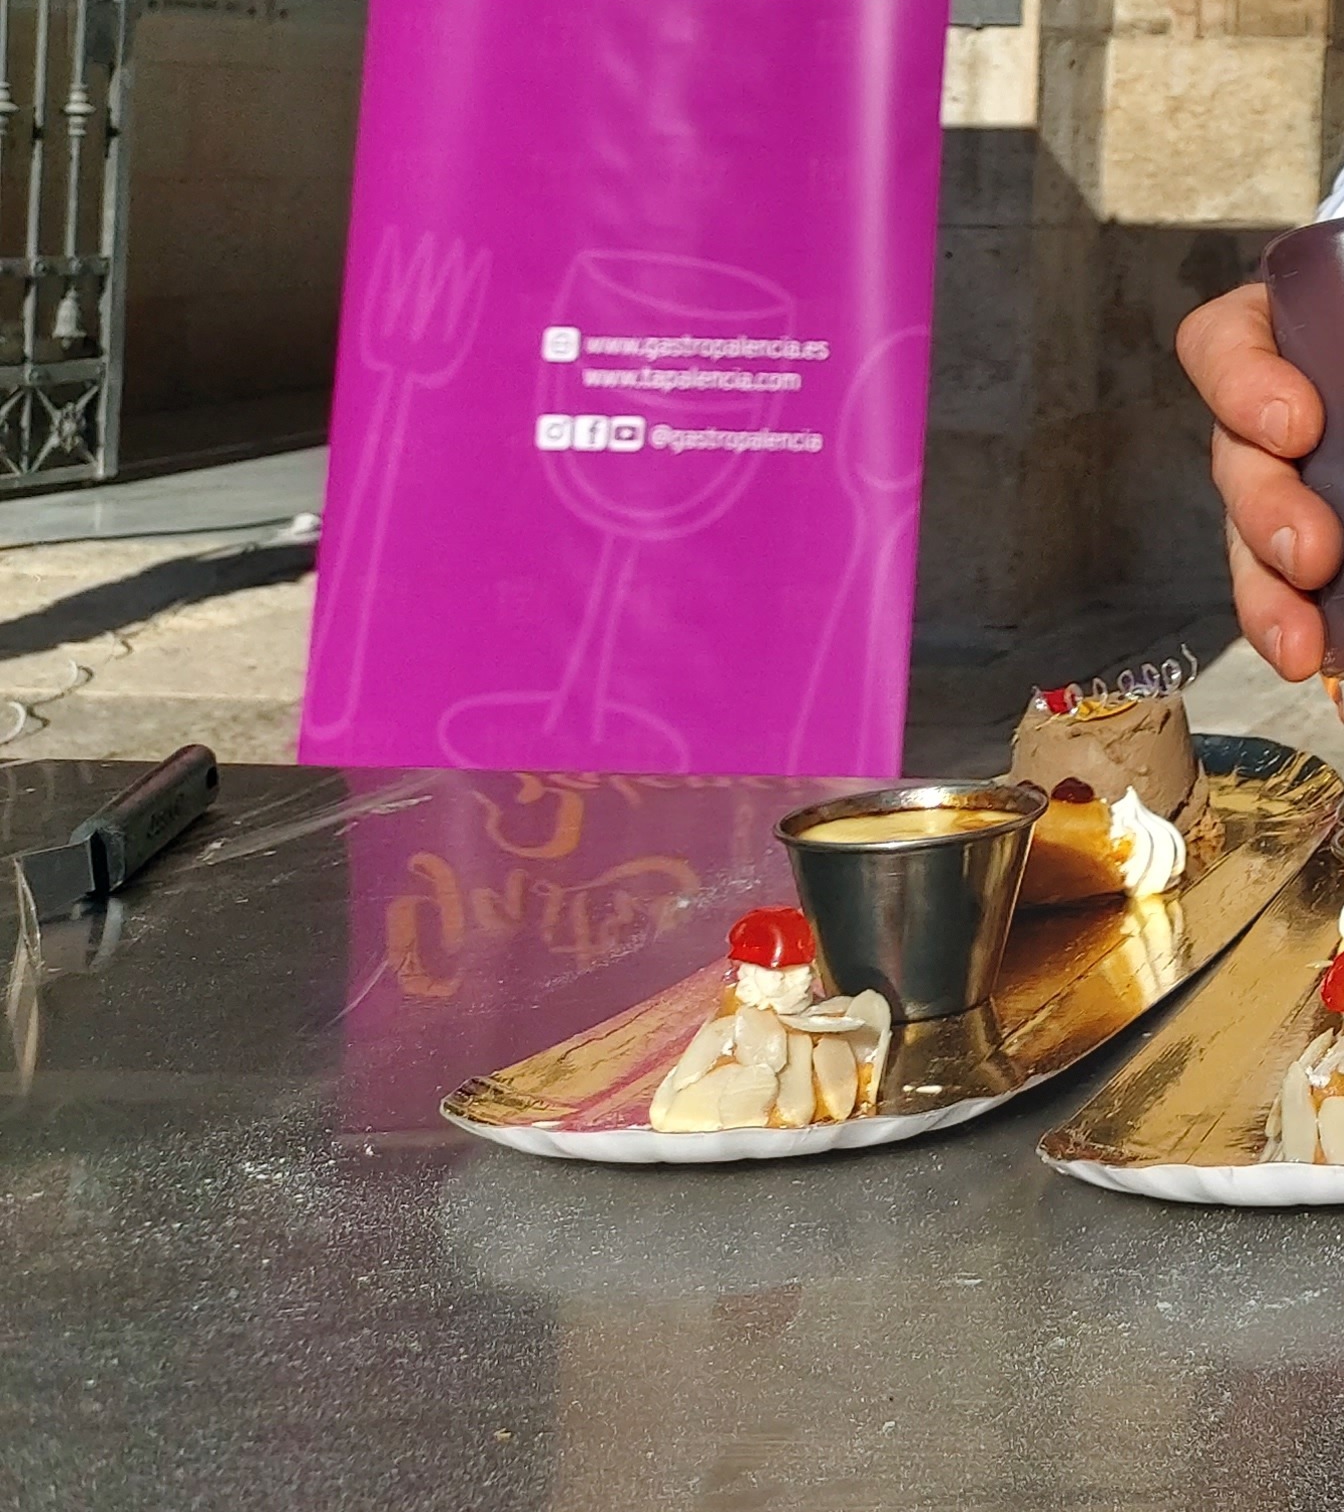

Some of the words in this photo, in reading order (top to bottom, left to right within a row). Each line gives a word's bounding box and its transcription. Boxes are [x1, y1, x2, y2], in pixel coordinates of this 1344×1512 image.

[586, 336, 829, 362] www.gastropalencia.es
[582, 366, 801, 393] www.tapalencia.com
[651, 425, 823, 454] @gastropalencia
